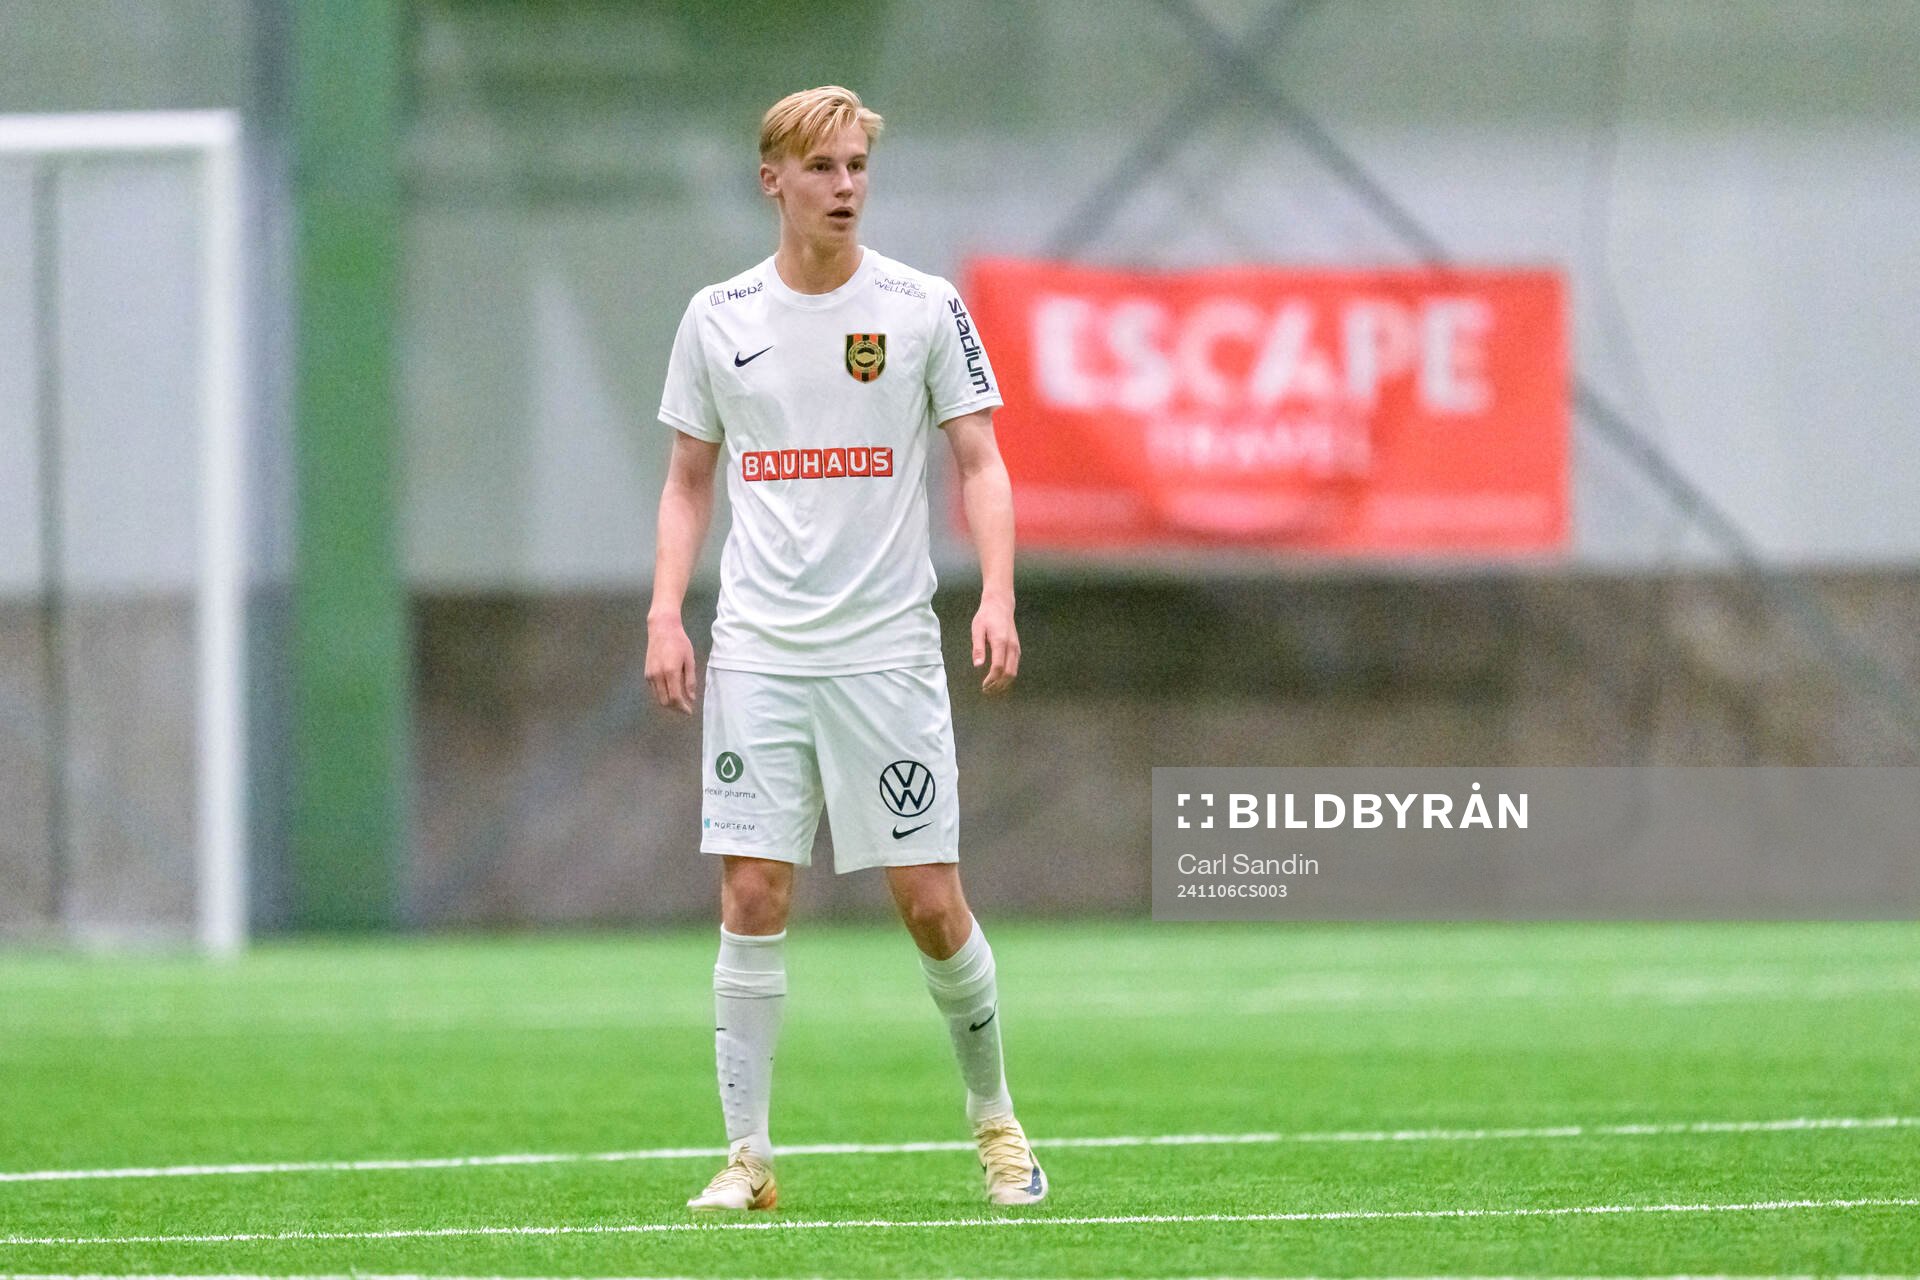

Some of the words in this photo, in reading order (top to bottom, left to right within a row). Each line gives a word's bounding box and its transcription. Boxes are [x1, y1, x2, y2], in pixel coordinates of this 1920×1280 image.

[874, 279, 927, 299] WELLNESS
[948, 298, 990, 394] stadium
[1030, 294, 1494, 414] ESCAPE
[744, 450, 890, 477] BAUHAUS
[724, 789, 756, 799] pharma
